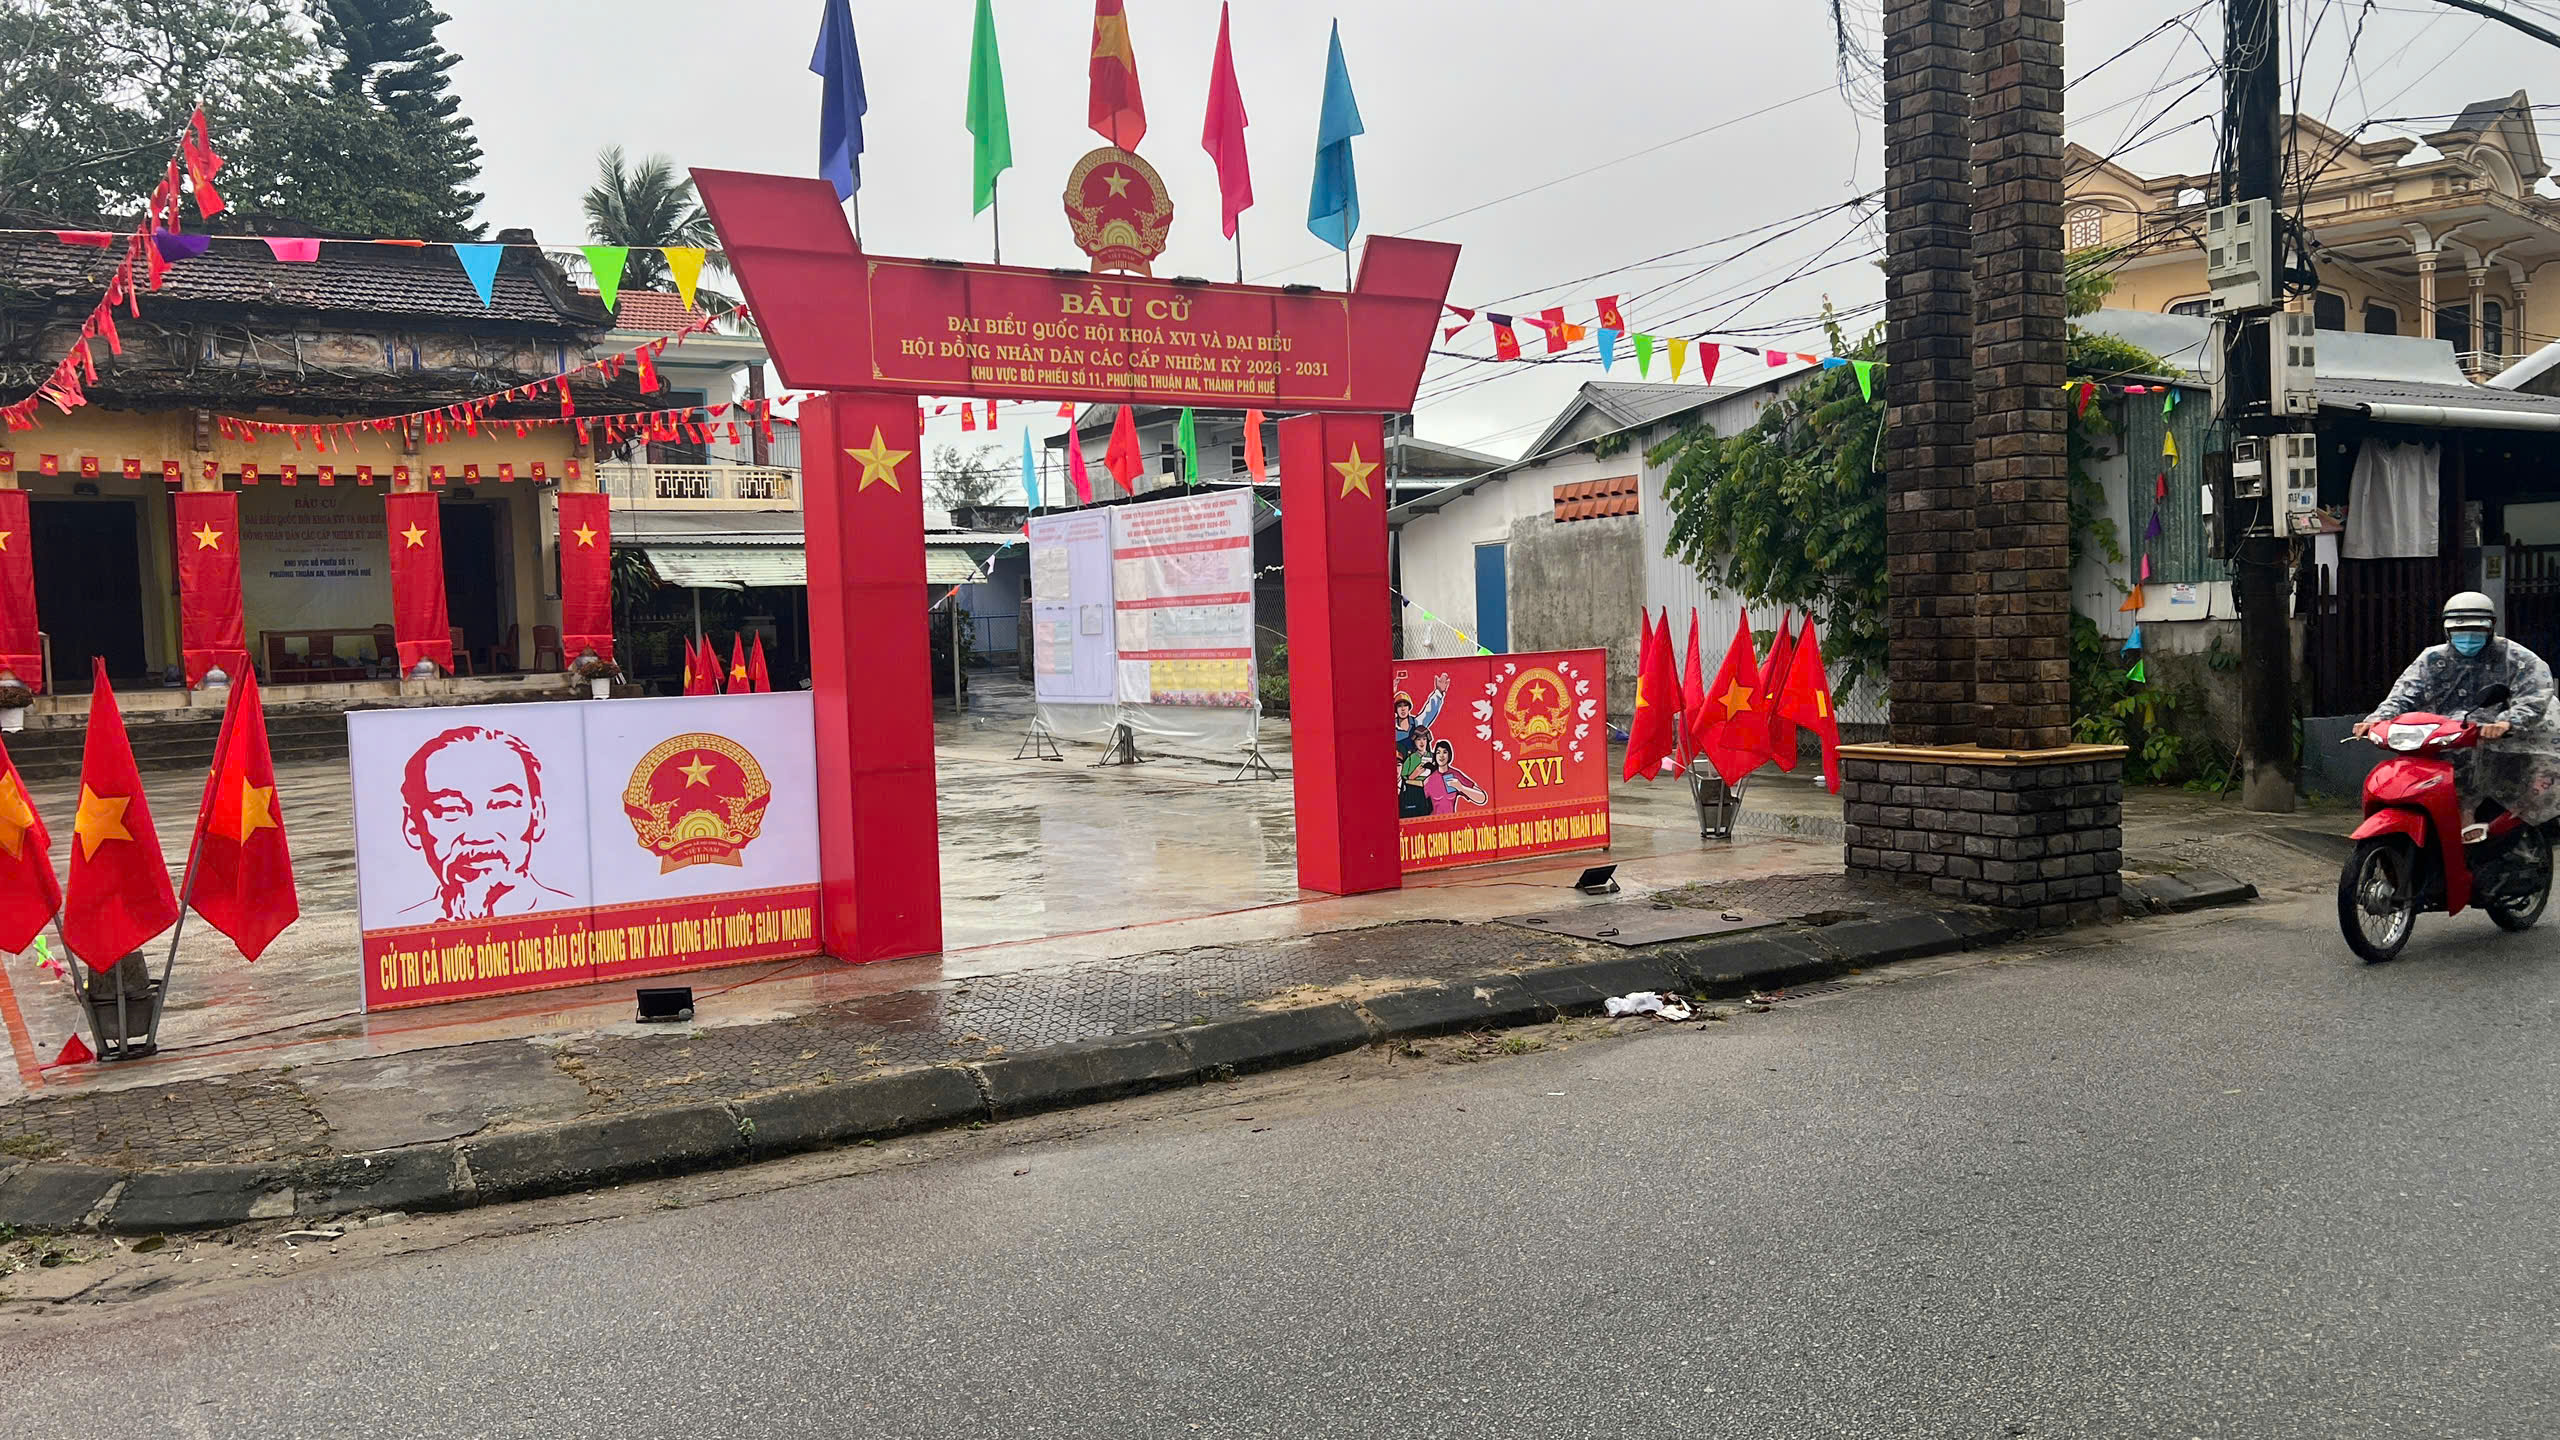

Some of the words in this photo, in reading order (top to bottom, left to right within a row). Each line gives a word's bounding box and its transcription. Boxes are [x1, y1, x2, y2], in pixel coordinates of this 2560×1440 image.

[1060, 284, 1133, 318] BẦU
[1145, 294, 1193, 322] CỬ
[947, 316, 980, 336] ĐẠI
[985, 312, 1027, 336] BIỂU
[1032, 317, 1079, 341] QUỐC
[1084, 323, 1114, 345] HỘI
[1169, 330, 1197, 347] XVI
[1200, 330, 1222, 349] VÀ
[1226, 335, 1253, 353] ĐẠI
[1257, 330, 1293, 352] BIỂU
[901, 336, 935, 359] HỘI
[940, 334, 991, 361] ĐỒNG
[996, 343, 1045, 362] NHÂN
[1049, 346, 1084, 365] DÂN
[1090, 347, 1124, 367] CÁC
[1128, 347, 1161, 369] CẤP
[1165, 353, 1217, 374] NHIỆM
[1220, 356, 1241, 373] KỲ
[1247, 360, 1281, 375] 2026
[1295, 362, 1329, 376] 2031
[971, 365, 994, 381] KHU
[996, 366, 1018, 384] VỰC
[1020, 364, 1035, 383] BỎ
[1038, 366, 1069, 385] PHIẾU
[1072, 366, 1085, 385] SỐ
[1089, 372, 1104, 387] 11,
[1107, 370, 1148, 389] PHƯỜNG
[1150, 373, 1182, 392] THUẬN
[1184, 376, 1201, 391] AN,
[1203, 375, 1235, 392] THÀNH
[1237, 377, 1255, 393] PHỐ
[1257, 377, 1276, 394] HUẾ
[1517, 756, 1565, 789] XVI
[1410, 831, 1427, 865] LỰA
[1427, 831, 1449, 862] CHỌN
[1450, 823, 1474, 855] NGƯỜI
[1476, 822, 1497, 852] XỨNG
[1498, 819, 1520, 849] ĐÁNG
[1520, 822, 1534, 850] ĐẠI
[1535, 815, 1553, 849] DIỆN
[1553, 816, 1569, 841] CHO
[1569, 810, 1591, 839] NHÂN
[1591, 808, 1607, 836] DÂN
[379, 941, 399, 991] CỬ
[399, 951, 420, 988] TRI
[422, 937, 440, 986] CẢ
[441, 938, 475, 983] NƯỚC
[477, 931, 510, 980] ĐỒNG
[512, 931, 542, 975] LÒNG
[544, 924, 568, 971] BẦU
[569, 921, 586, 968] CỬ
[588, 926, 626, 967] CHUNG
[627, 925, 646, 960] TAY
[648, 916, 669, 958] XÂY
[671, 917, 701, 962] DỰNG
[703, 905, 723, 952] ĐẤT
[725, 907, 753, 949] NƯỚC
[755, 904, 779, 944] GIÀU
[781, 907, 812, 948] MẠNH
